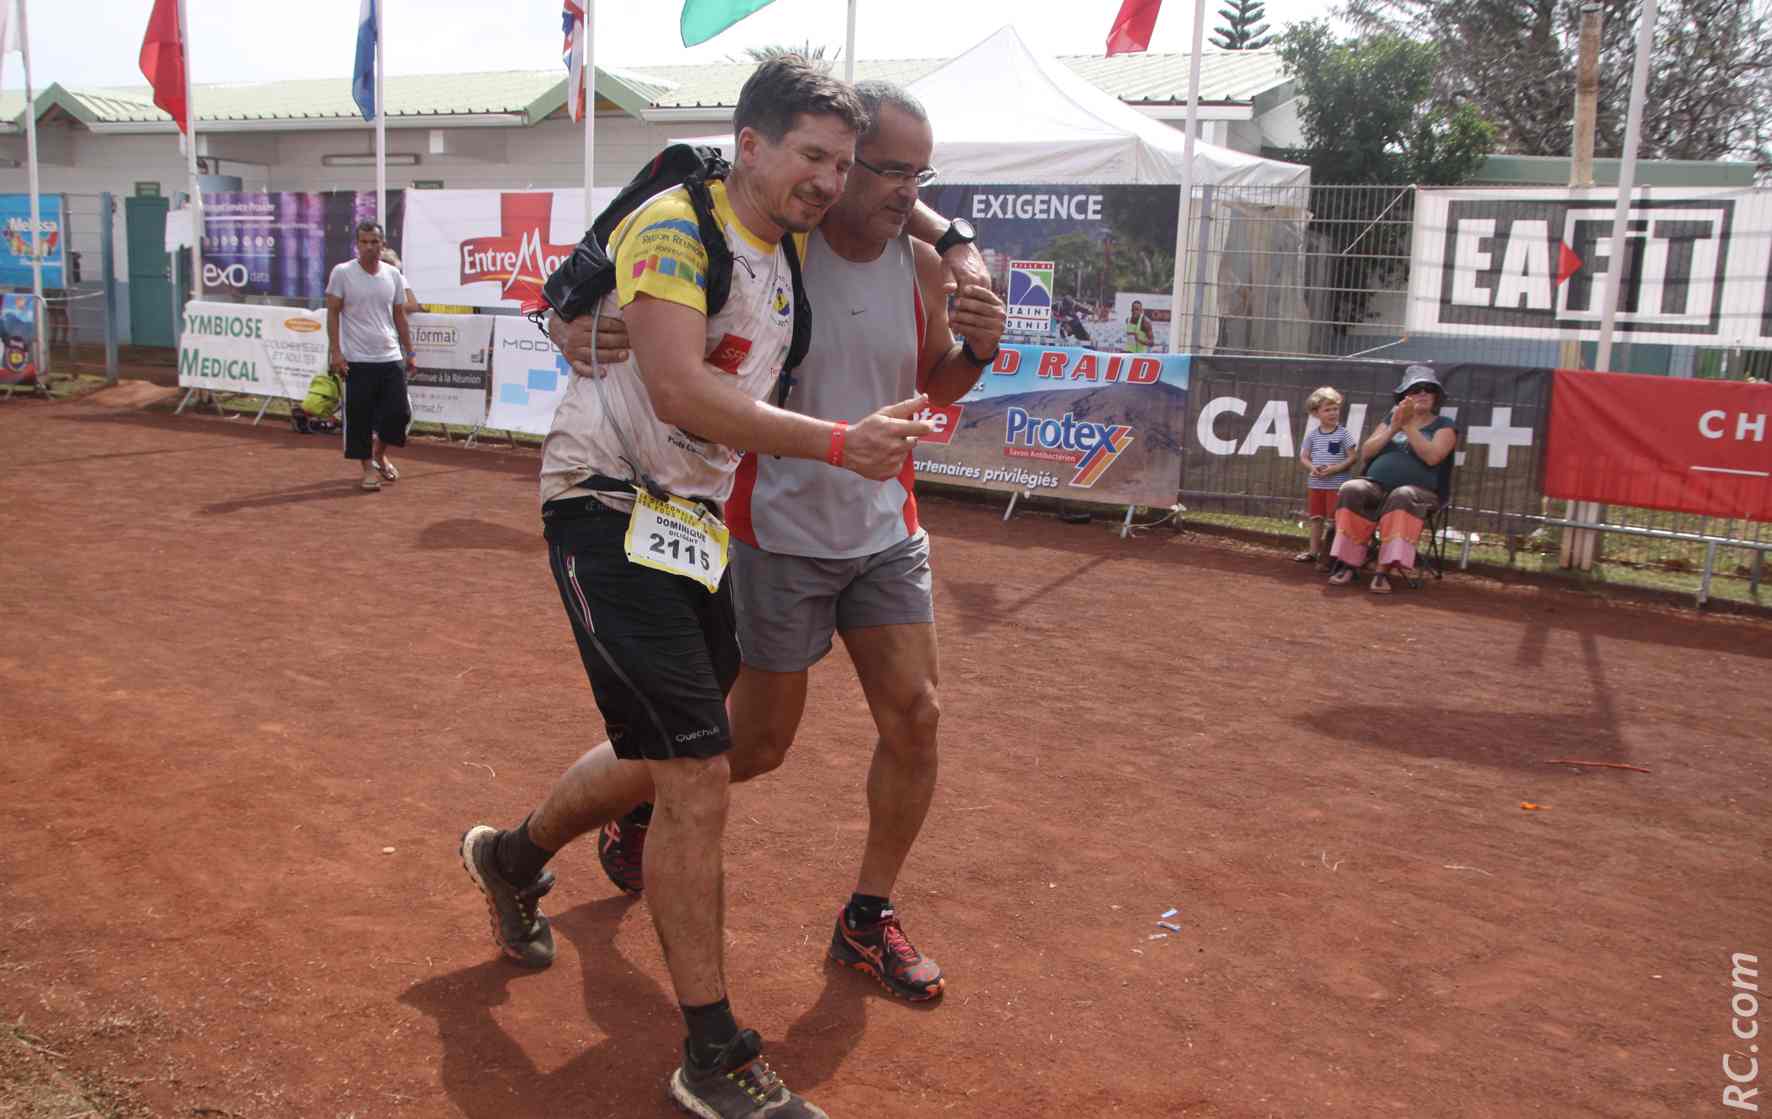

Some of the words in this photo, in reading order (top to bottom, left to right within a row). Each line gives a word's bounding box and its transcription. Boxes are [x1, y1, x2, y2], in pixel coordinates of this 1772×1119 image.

[971, 194, 1103, 220] EXIGENCE
[203, 263, 249, 287] exo
[187, 314, 263, 339] YMBIOSE
[1008, 320, 1049, 330] DENIS
[1009, 307, 1050, 317] SAINT
[179, 347, 260, 382] MEDICAL
[1036, 351, 1162, 385] RAID
[1005, 406, 1119, 466] Protex
[1697, 409, 1767, 443] CH
[912, 459, 981, 478] artenaires
[982, 465, 1059, 489] privilégiés
[656, 515, 706, 543] DOMINIQUE
[648, 532, 711, 571] 2115
